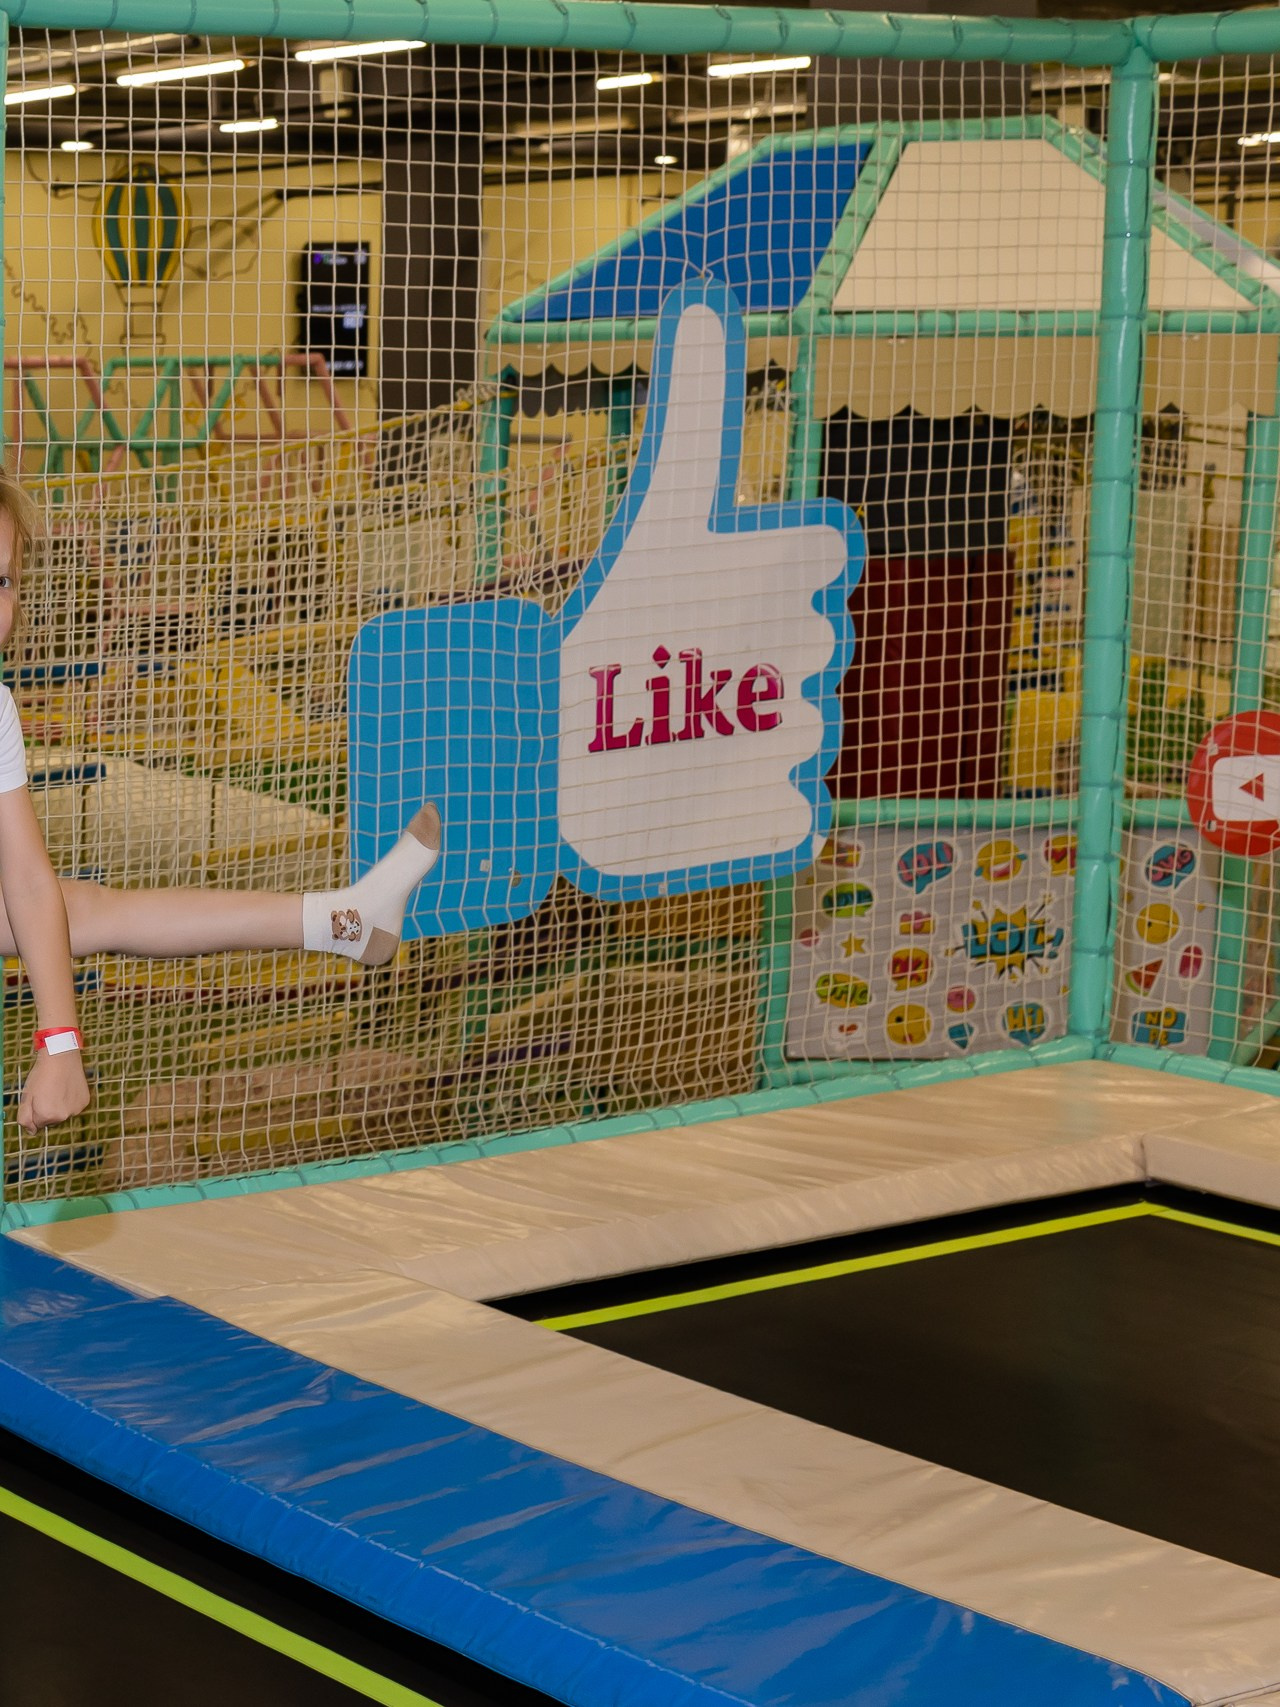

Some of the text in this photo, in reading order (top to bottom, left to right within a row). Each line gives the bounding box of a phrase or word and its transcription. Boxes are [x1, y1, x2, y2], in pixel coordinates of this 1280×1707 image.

[588, 645, 784, 752] Like
[962, 921, 1064, 959] LOL!
[1007, 1007, 1045, 1034] Hi!
